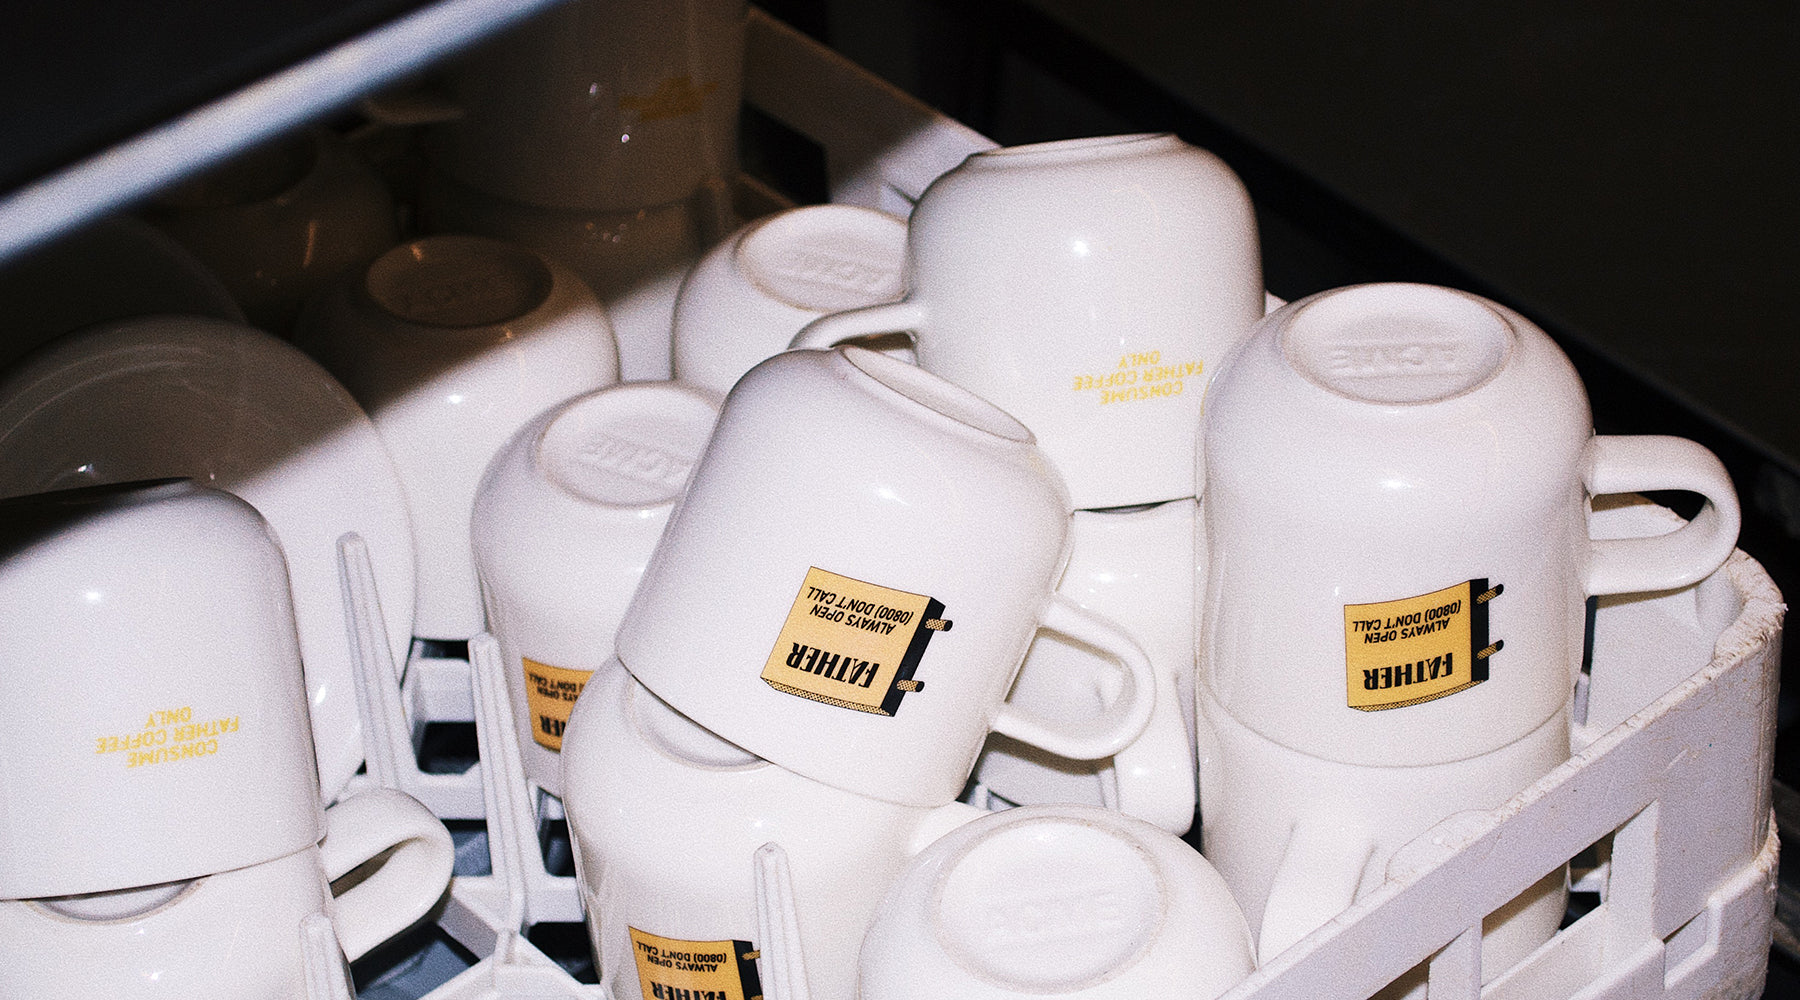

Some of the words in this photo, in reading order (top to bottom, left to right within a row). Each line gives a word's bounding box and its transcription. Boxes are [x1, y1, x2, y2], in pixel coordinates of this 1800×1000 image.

[1118, 350, 1161, 369] ONLY
[1073, 370, 1138, 391] COFFEE
[1143, 360, 1204, 382] FATHER
[1100, 381, 1183, 405] CONSUME
[806, 586, 837, 605] CALL
[809, 604, 845, 623] OPEN
[835, 596, 875, 615] DON'T
[1425, 600, 1461, 623] (0800)
[874, 605, 914, 626] (0800)
[1384, 612, 1421, 629] DON'T
[845, 617, 896, 635] ALWAYS
[1352, 619, 1382, 632] CALL
[1400, 617, 1450, 640] ALWAYS
[1364, 629, 1397, 644] OPEN
[786, 642, 880, 688] FATHER
[1362, 652, 1453, 690] FATHER
[528, 673, 548, 687] CALL
[537, 687, 560, 700] OPEN
[144, 706, 192, 729] ONLY
[173, 716, 239, 742] FATHER
[95, 729, 167, 754] COFFEE
[126, 738, 218, 768] CONSUME
[636, 941, 658, 956] CALL
[661, 949, 690, 960] DON'T
[694, 953, 727, 963] (0800)
[647, 954, 672, 968] OPEN
[676, 962, 718, 972] ALWAYS
